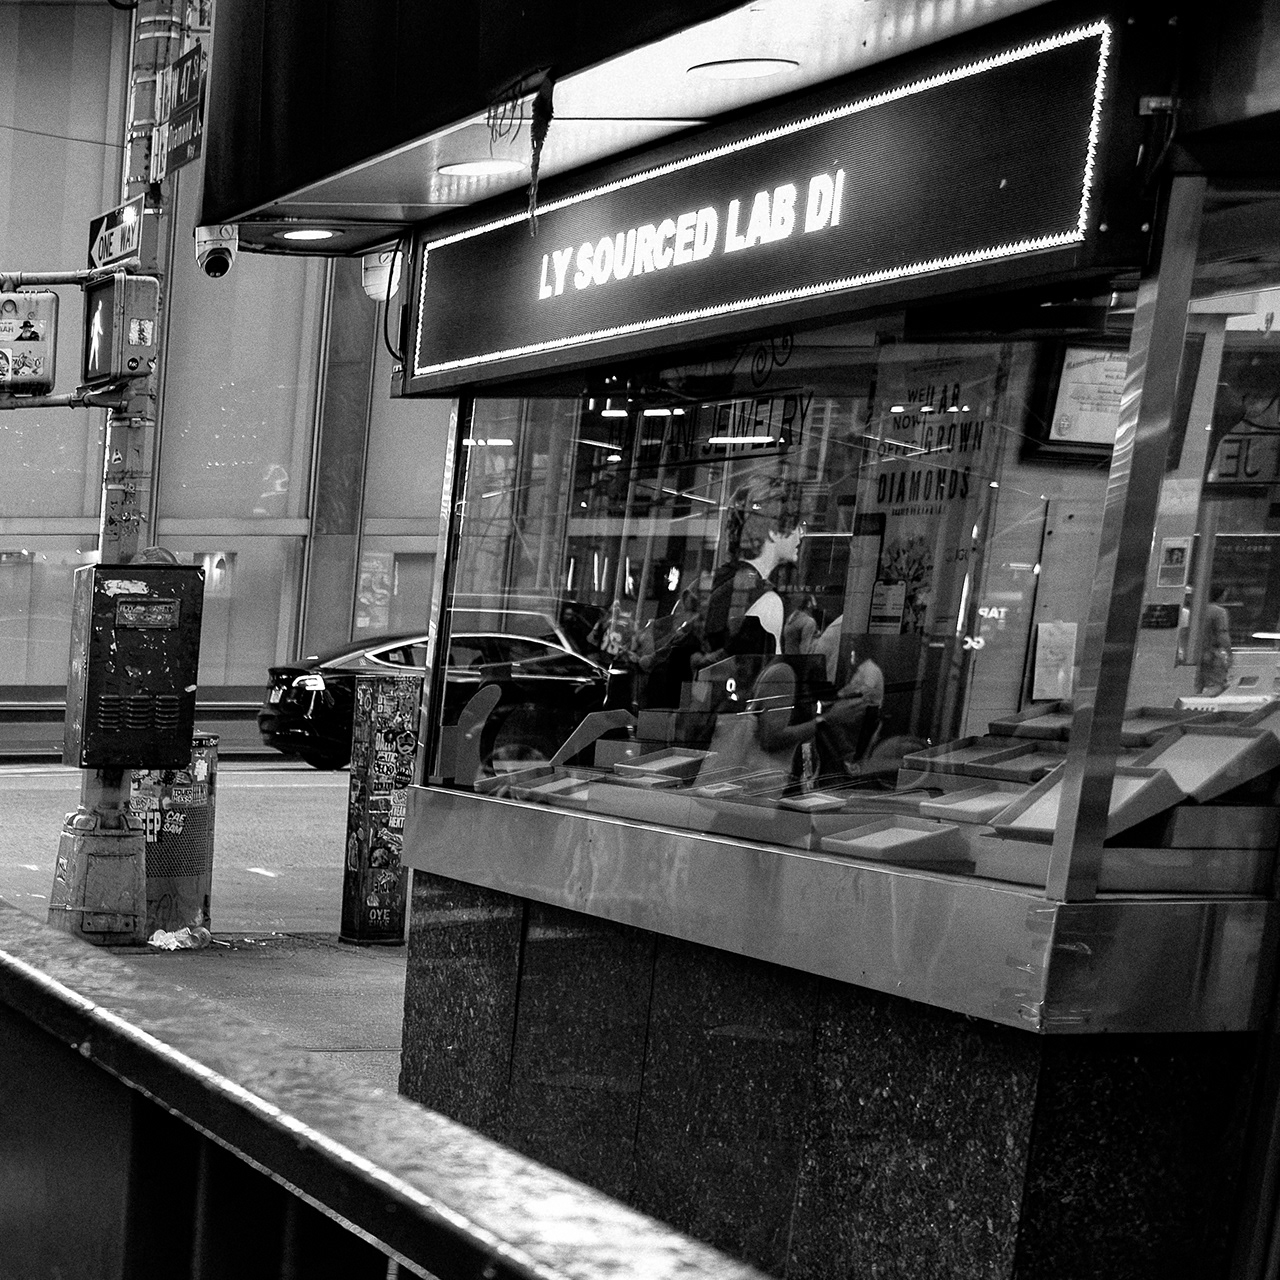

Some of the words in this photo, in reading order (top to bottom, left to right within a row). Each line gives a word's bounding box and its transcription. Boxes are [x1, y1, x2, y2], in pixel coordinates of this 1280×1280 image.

[180, 59, 192, 103] 47
[98, 231, 114, 260] ONE
[120, 219, 137, 252] WAY
[573, 206, 719, 290] SOURCED
[724, 182, 798, 253] LAB
[702, 391, 814, 455] JEWELRY
[924, 421, 984, 455] GROWN
[877, 466, 972, 503] DIAMONDS
